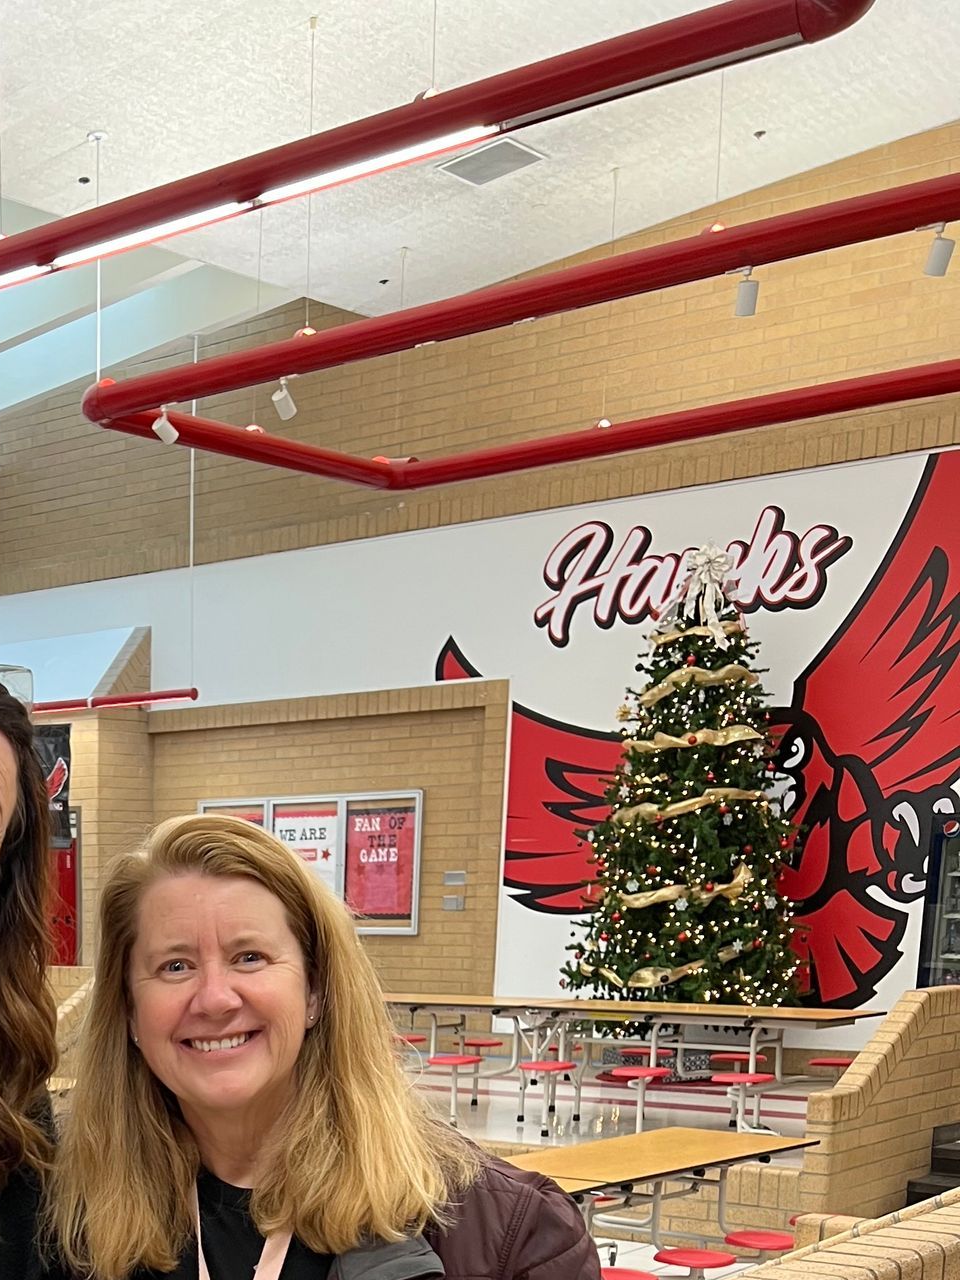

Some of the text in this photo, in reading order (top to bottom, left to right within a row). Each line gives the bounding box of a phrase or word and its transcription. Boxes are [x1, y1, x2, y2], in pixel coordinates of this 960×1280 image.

[534, 505, 853, 648] Haks
[354, 816, 406, 832] FAN OF
[280, 828, 327, 842] WE ARE
[367, 834, 397, 848] THE
[360, 849, 398, 863] GAME
